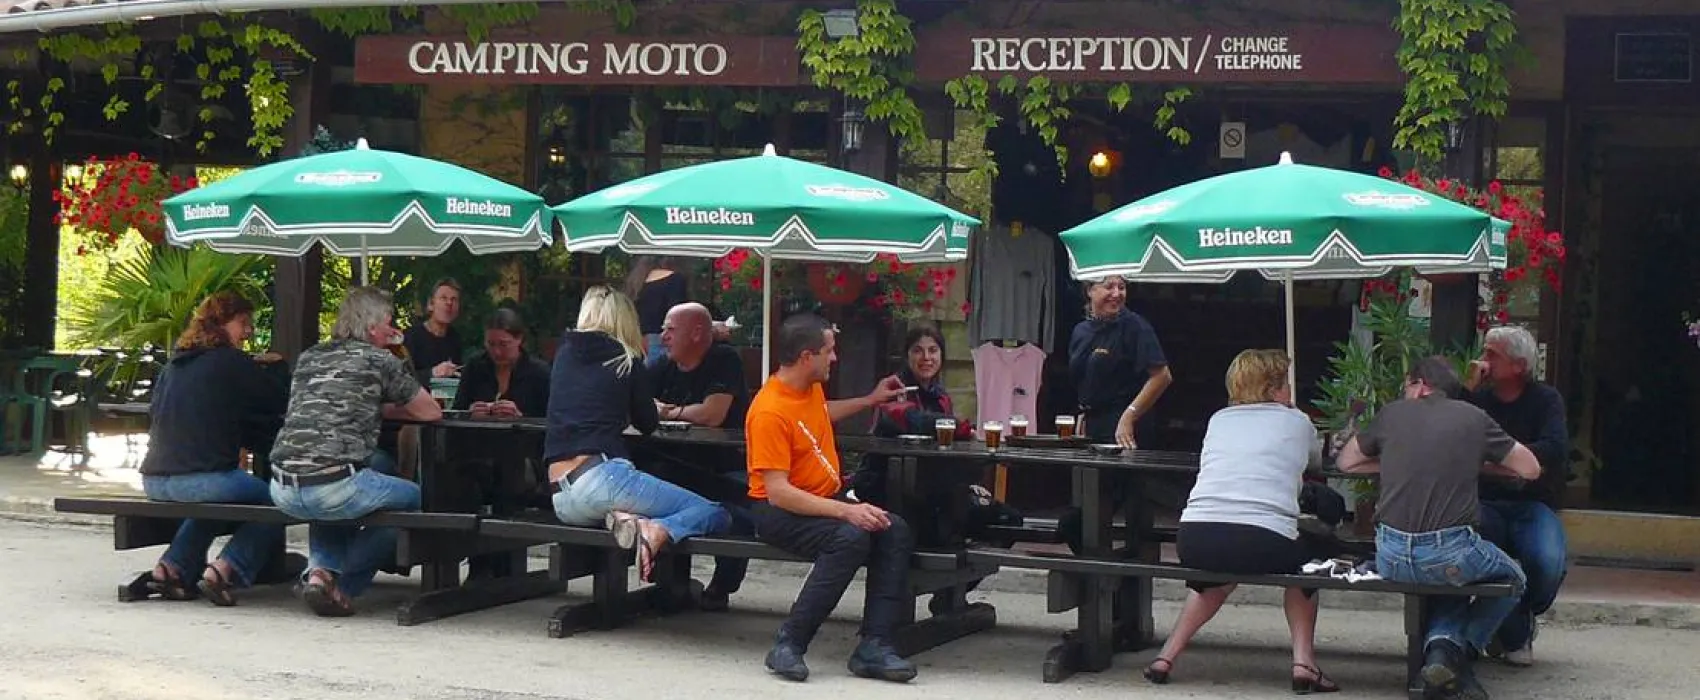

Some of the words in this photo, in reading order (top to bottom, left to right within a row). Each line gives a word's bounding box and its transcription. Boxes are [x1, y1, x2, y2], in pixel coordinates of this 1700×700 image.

[1221, 36, 1289, 54] CHANGE
[408, 41, 589, 75] CAMPING
[602, 42, 727, 76] MOTO
[1215, 54, 1302, 70] TELEPHONE
[183, 202, 231, 221] Heineken
[446, 197, 512, 217] Heineken
[665, 207, 754, 226] Heineken
[1198, 225, 1293, 248] Heineken
